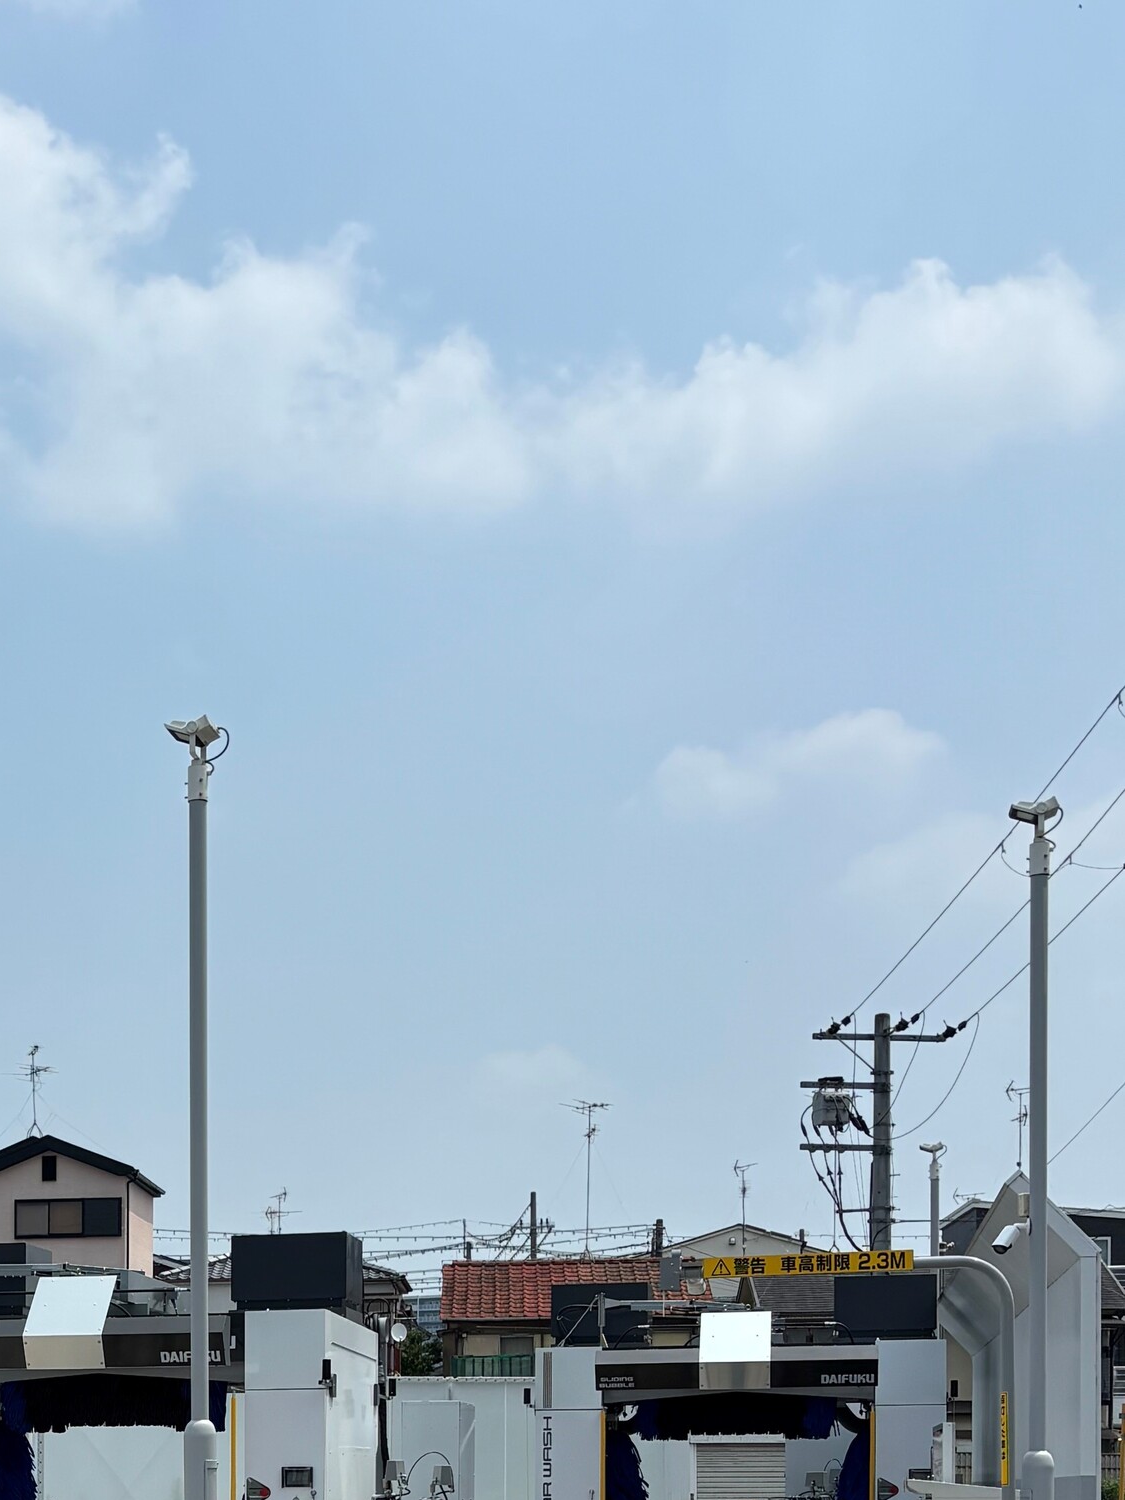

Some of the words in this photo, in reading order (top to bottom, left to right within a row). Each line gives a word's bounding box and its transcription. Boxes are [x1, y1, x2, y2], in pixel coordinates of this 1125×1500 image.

[734, 1257, 766, 1275] 警告
[781, 1253, 850, 1273] 車高制限
[858, 1252, 905, 1270] 2.3M
[820, 1373, 875, 1384] DAIFUKU
[542, 1416, 552, 1478] WASH
